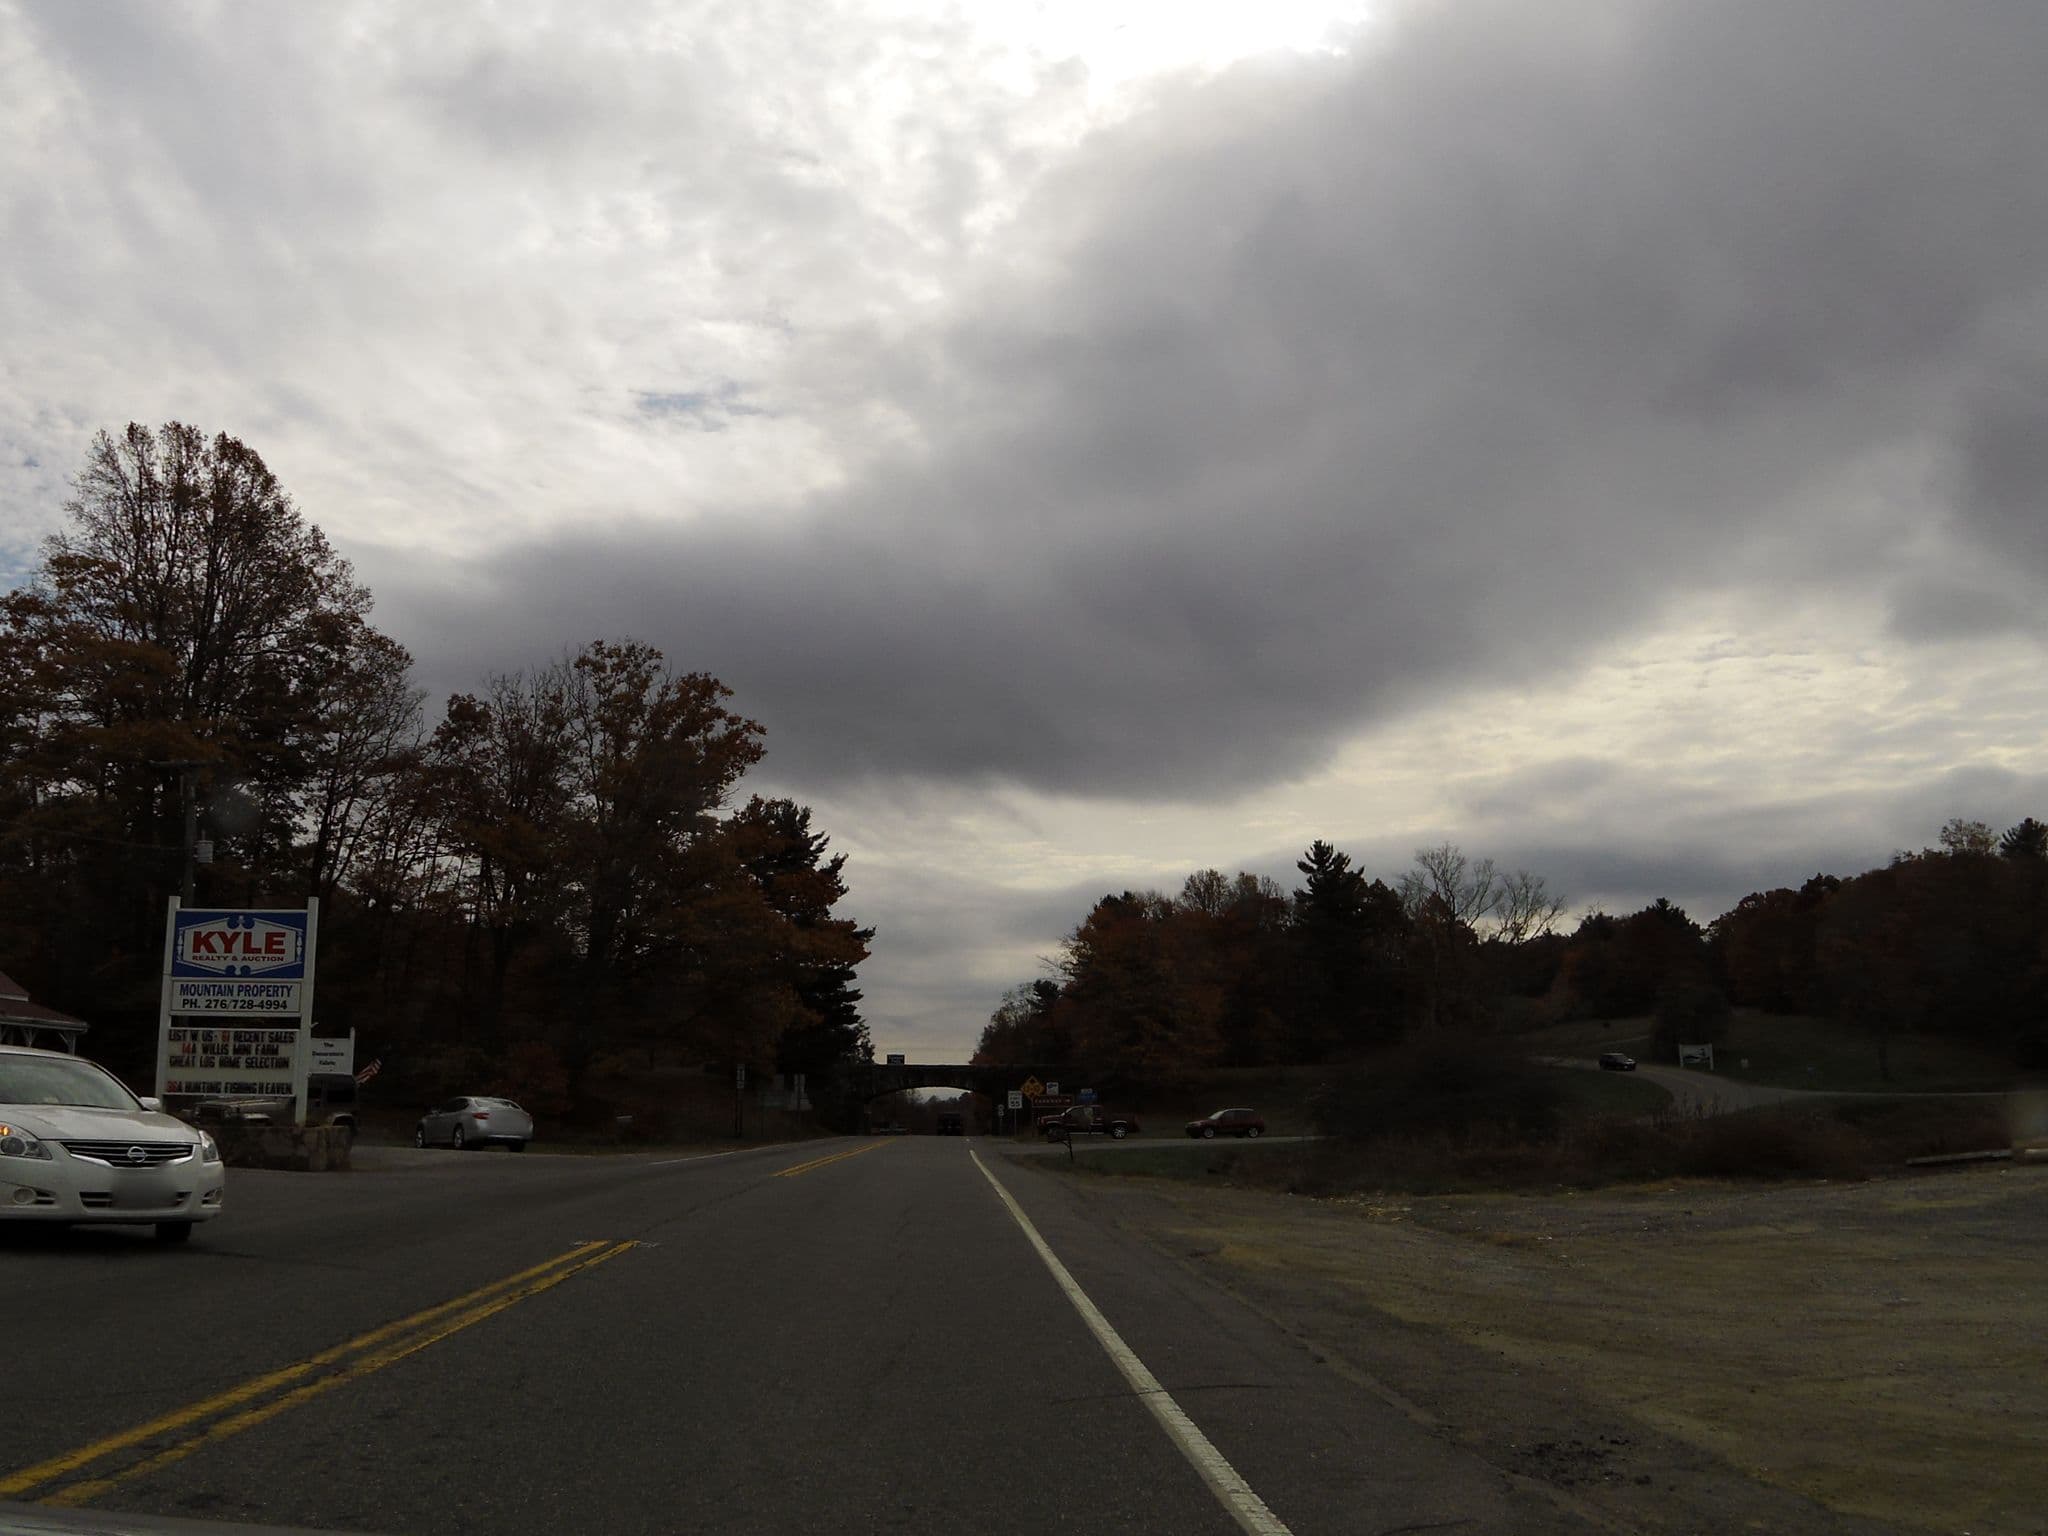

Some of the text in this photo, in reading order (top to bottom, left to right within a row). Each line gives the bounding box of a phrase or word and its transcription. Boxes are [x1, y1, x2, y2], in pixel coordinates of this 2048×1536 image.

[192, 931, 286, 954] KYLE
[180, 983, 293, 998] MOUNTAIN PROPERTY
[182, 999, 288, 1010] PH. 276/728-4994
[233, 1031, 265, 1043] RECENT
[268, 1031, 295, 1044] SALES
[202, 1044, 229, 1055] WILLIS
[256, 1044, 279, 1056] FARM
[245, 1056, 290, 1069] SELECTION
